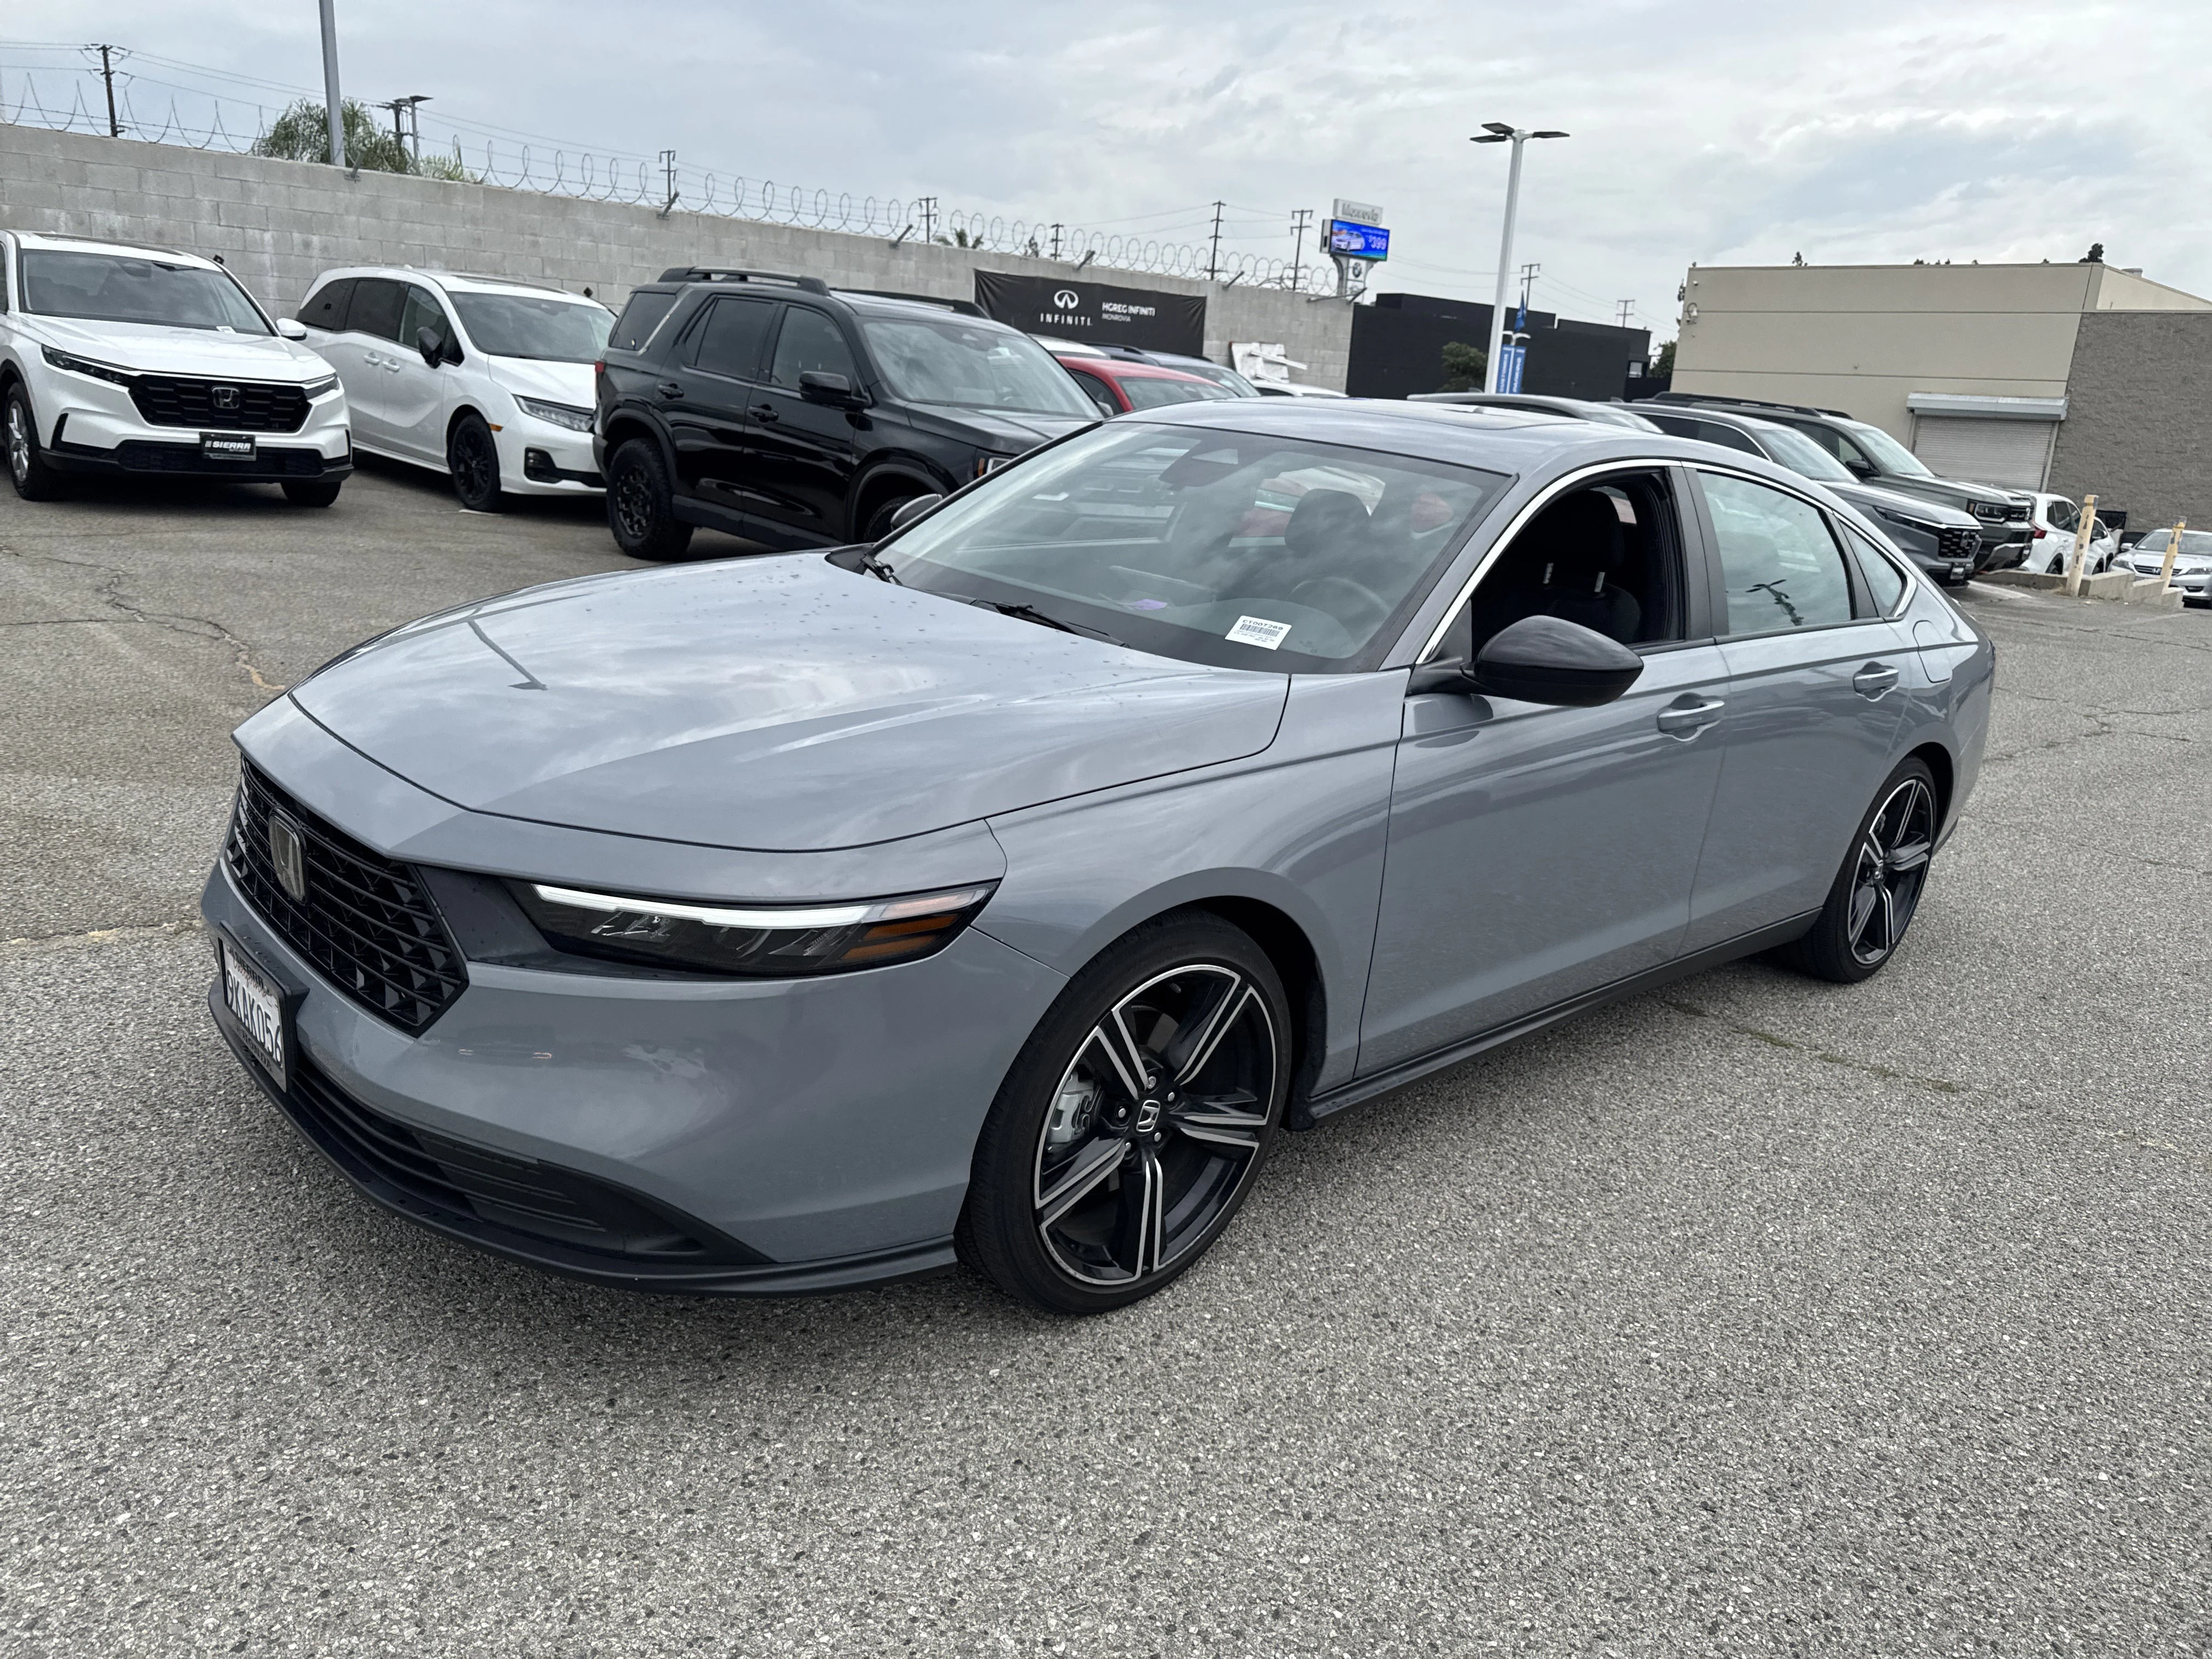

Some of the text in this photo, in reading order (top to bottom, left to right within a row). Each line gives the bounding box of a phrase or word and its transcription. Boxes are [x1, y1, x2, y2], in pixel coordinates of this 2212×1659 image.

[1127, 304, 1155, 317] INFINITI
[1040, 313, 1091, 326] INFINITI
[213, 441, 251, 449] SIERRA
